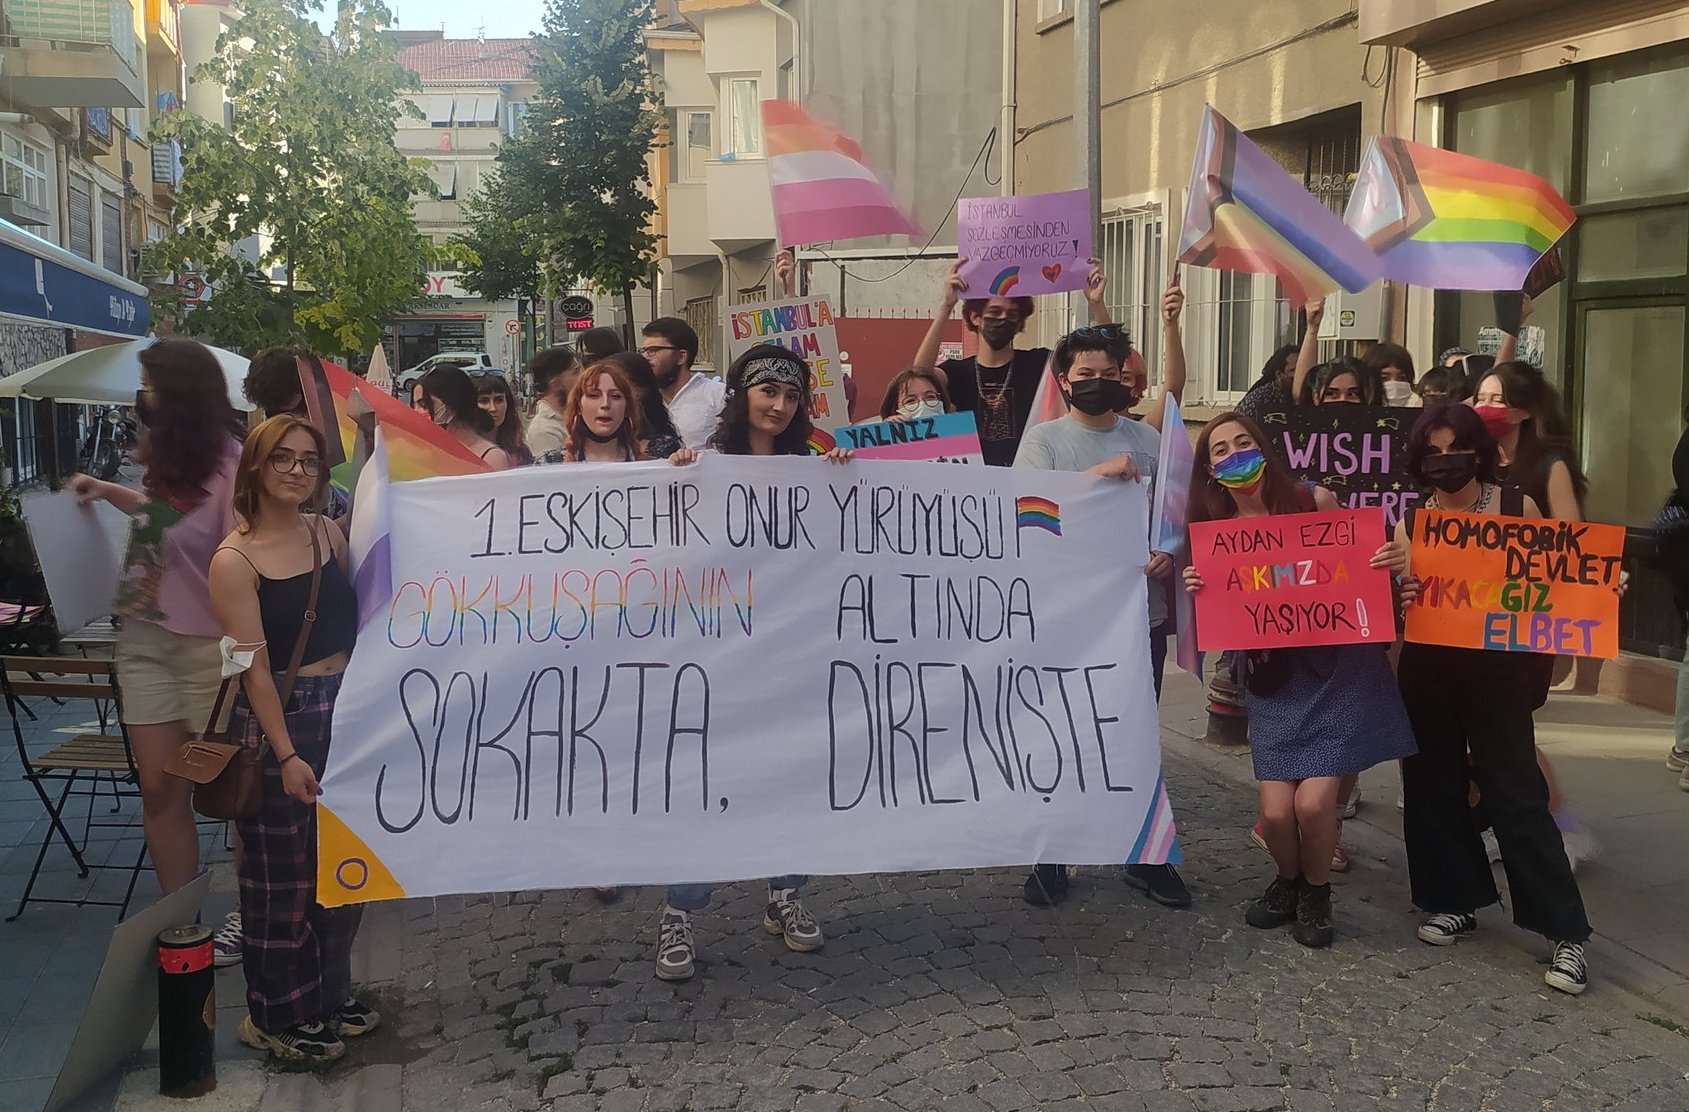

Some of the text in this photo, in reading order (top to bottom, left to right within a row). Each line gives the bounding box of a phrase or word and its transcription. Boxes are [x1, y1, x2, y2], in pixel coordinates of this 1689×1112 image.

[567, 320, 593, 328] TOST
[844, 418, 938, 449] YALNIZ
[1283, 431, 1391, 476] WISH
[725, 483, 816, 551] ONUR
[1211, 516, 1356, 556] AYDAN EZGİ
[1423, 513, 1590, 559] HOMOFOBİK
[1505, 545, 1622, 586] DEVLET
[387, 558, 1036, 649] GÖKKUŞAĞININ ALTINDA
[1483, 611, 1602, 657] ELBET
[828, 653, 1134, 812] DİRENİŞTE
